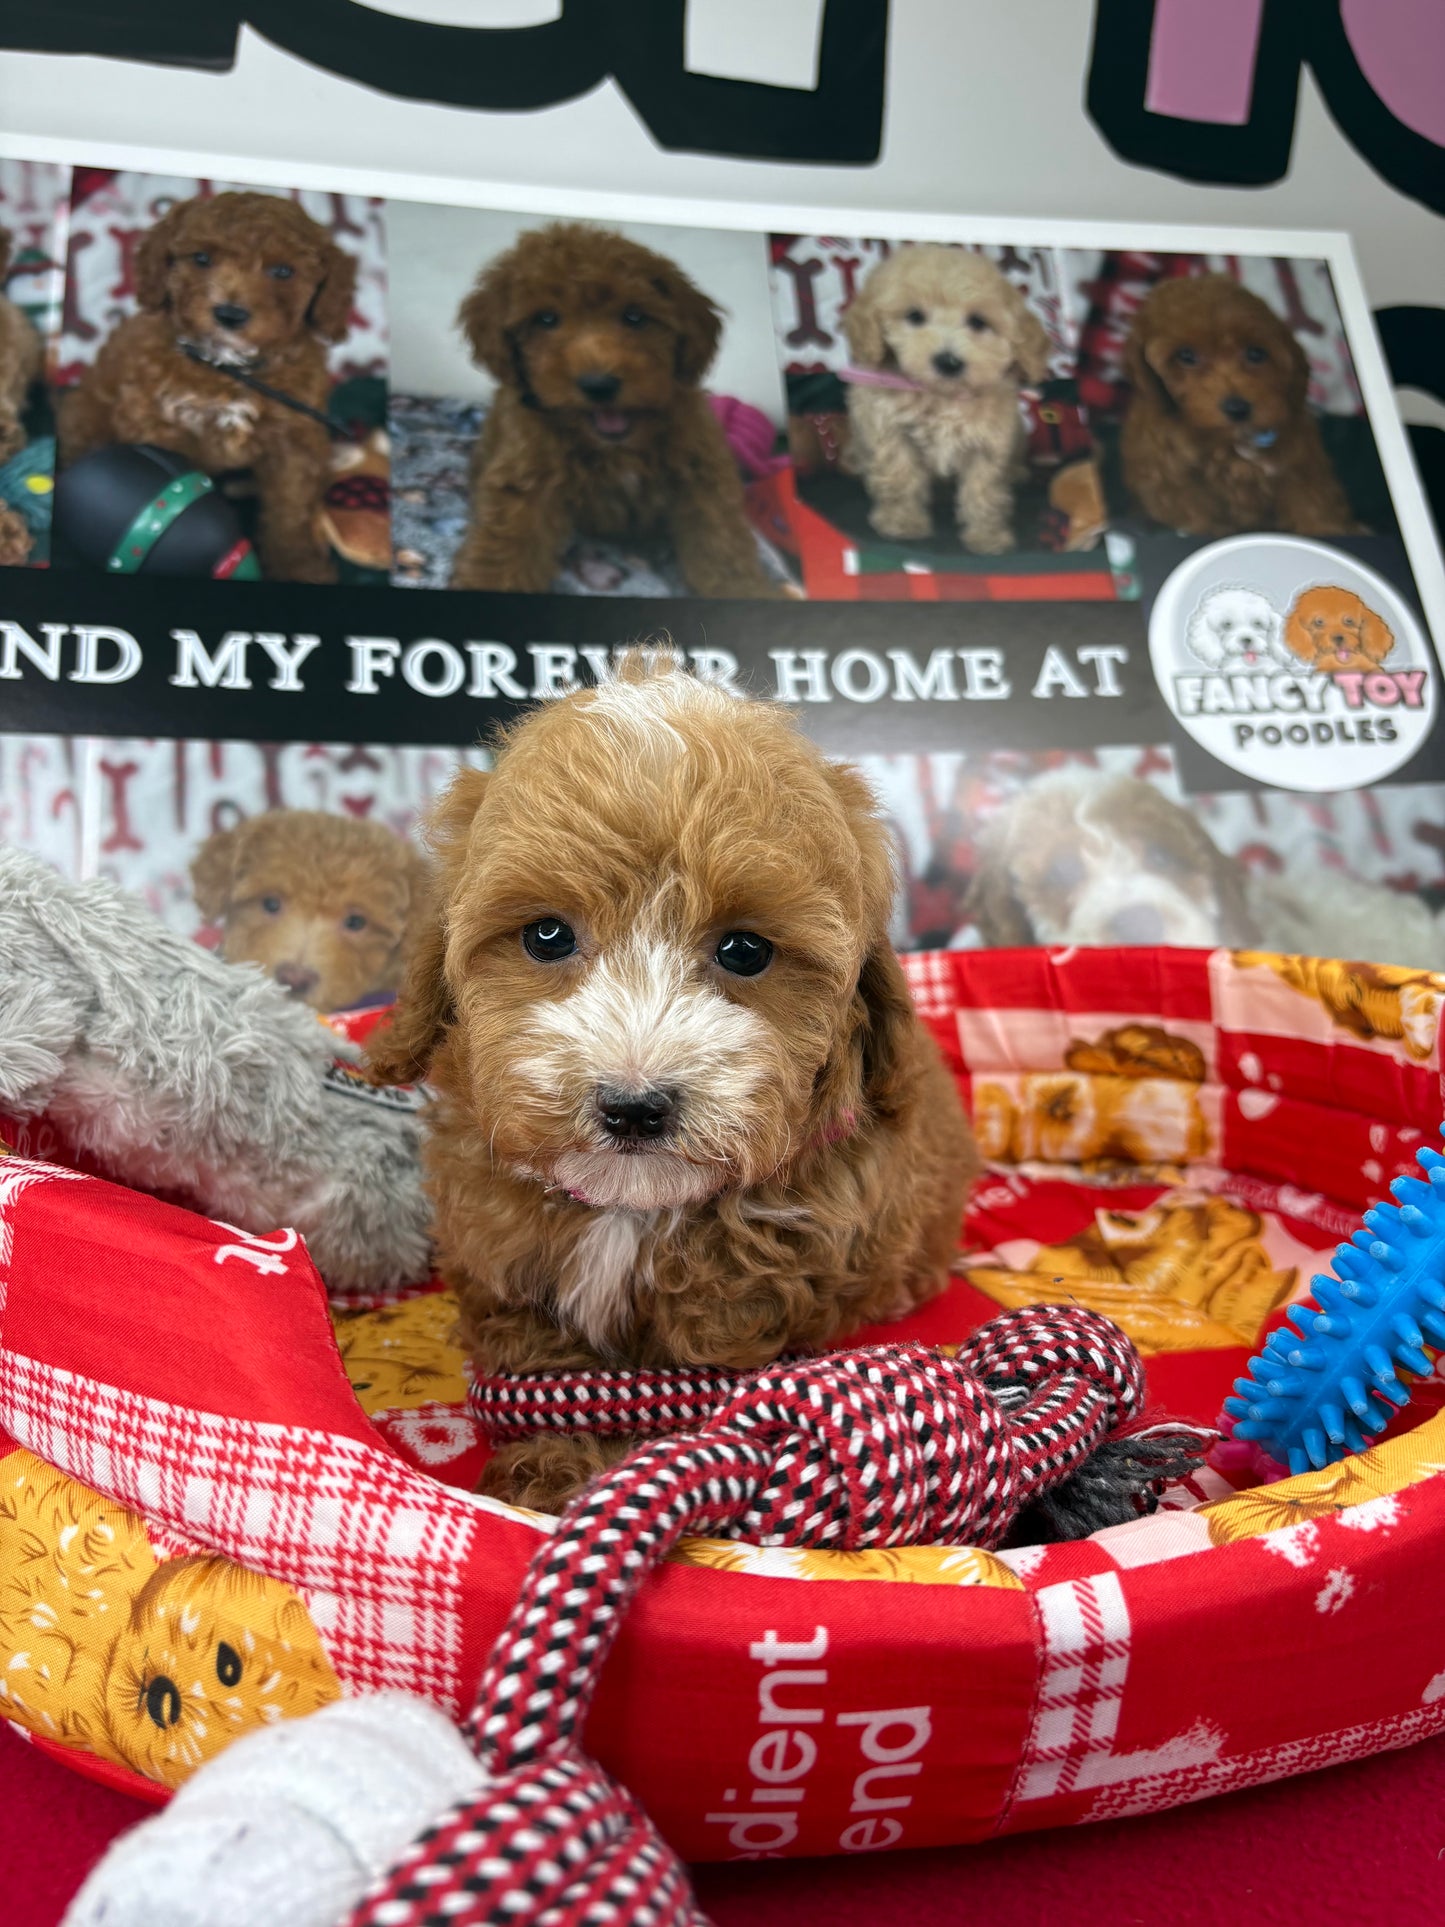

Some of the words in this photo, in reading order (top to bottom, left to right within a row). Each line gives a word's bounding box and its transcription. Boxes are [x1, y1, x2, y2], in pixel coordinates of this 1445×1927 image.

[0, 622, 143, 685] ND
[171, 629, 321, 692] MY
[768, 647, 1011, 704] HOME
[1032, 644, 1130, 699] AT
[1174, 671, 1328, 716] FANCY
[1333, 670, 1427, 710] TOY
[1233, 718, 1398, 748] POODLES
[705, 1624, 829, 1861] dient
